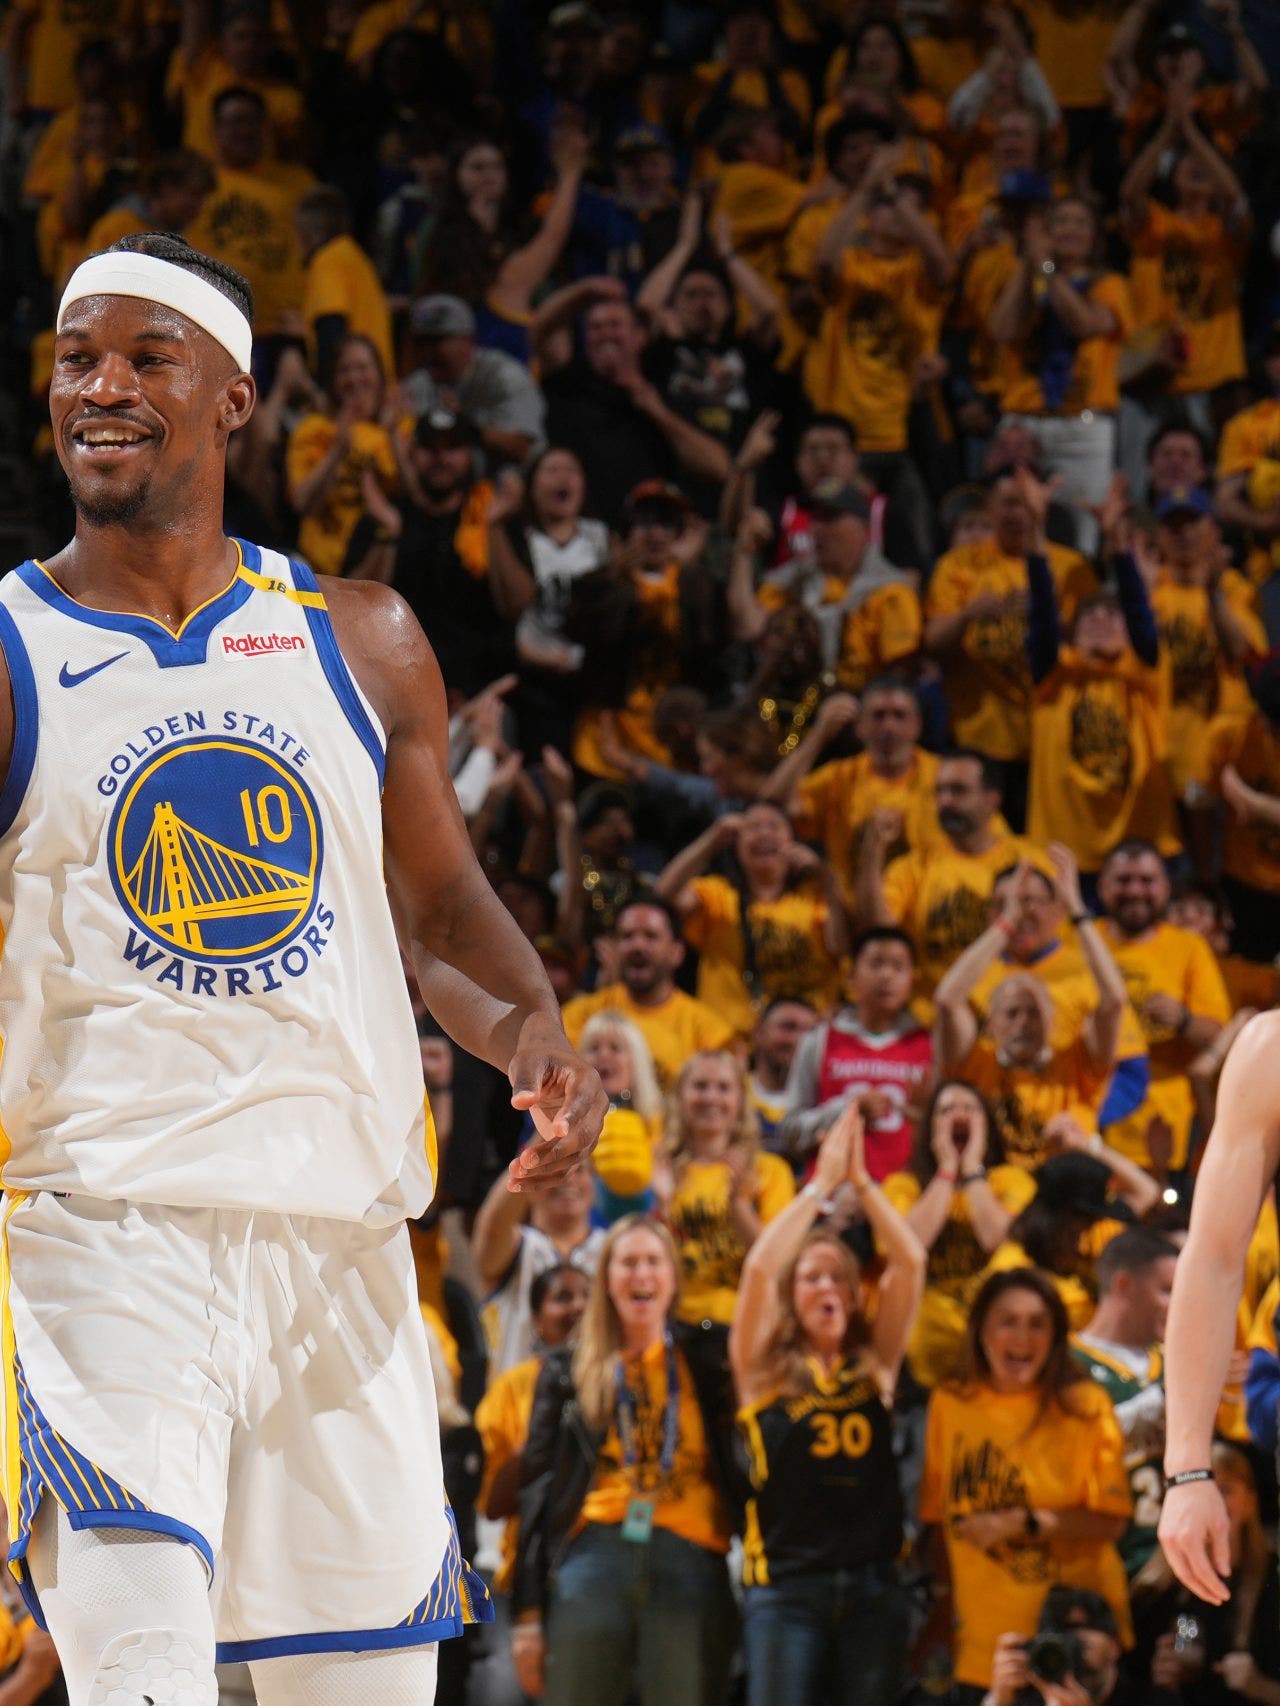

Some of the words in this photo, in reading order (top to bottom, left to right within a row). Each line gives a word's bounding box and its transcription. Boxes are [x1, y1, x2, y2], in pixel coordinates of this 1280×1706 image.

[222, 632, 306, 656] Rakuten
[98, 710, 207, 797] GOLDEN
[223, 710, 311, 769] STATE
[239, 784, 295, 848] 10
[122, 902, 336, 997] WARRIORS
[808, 1410, 874, 1460] 30
